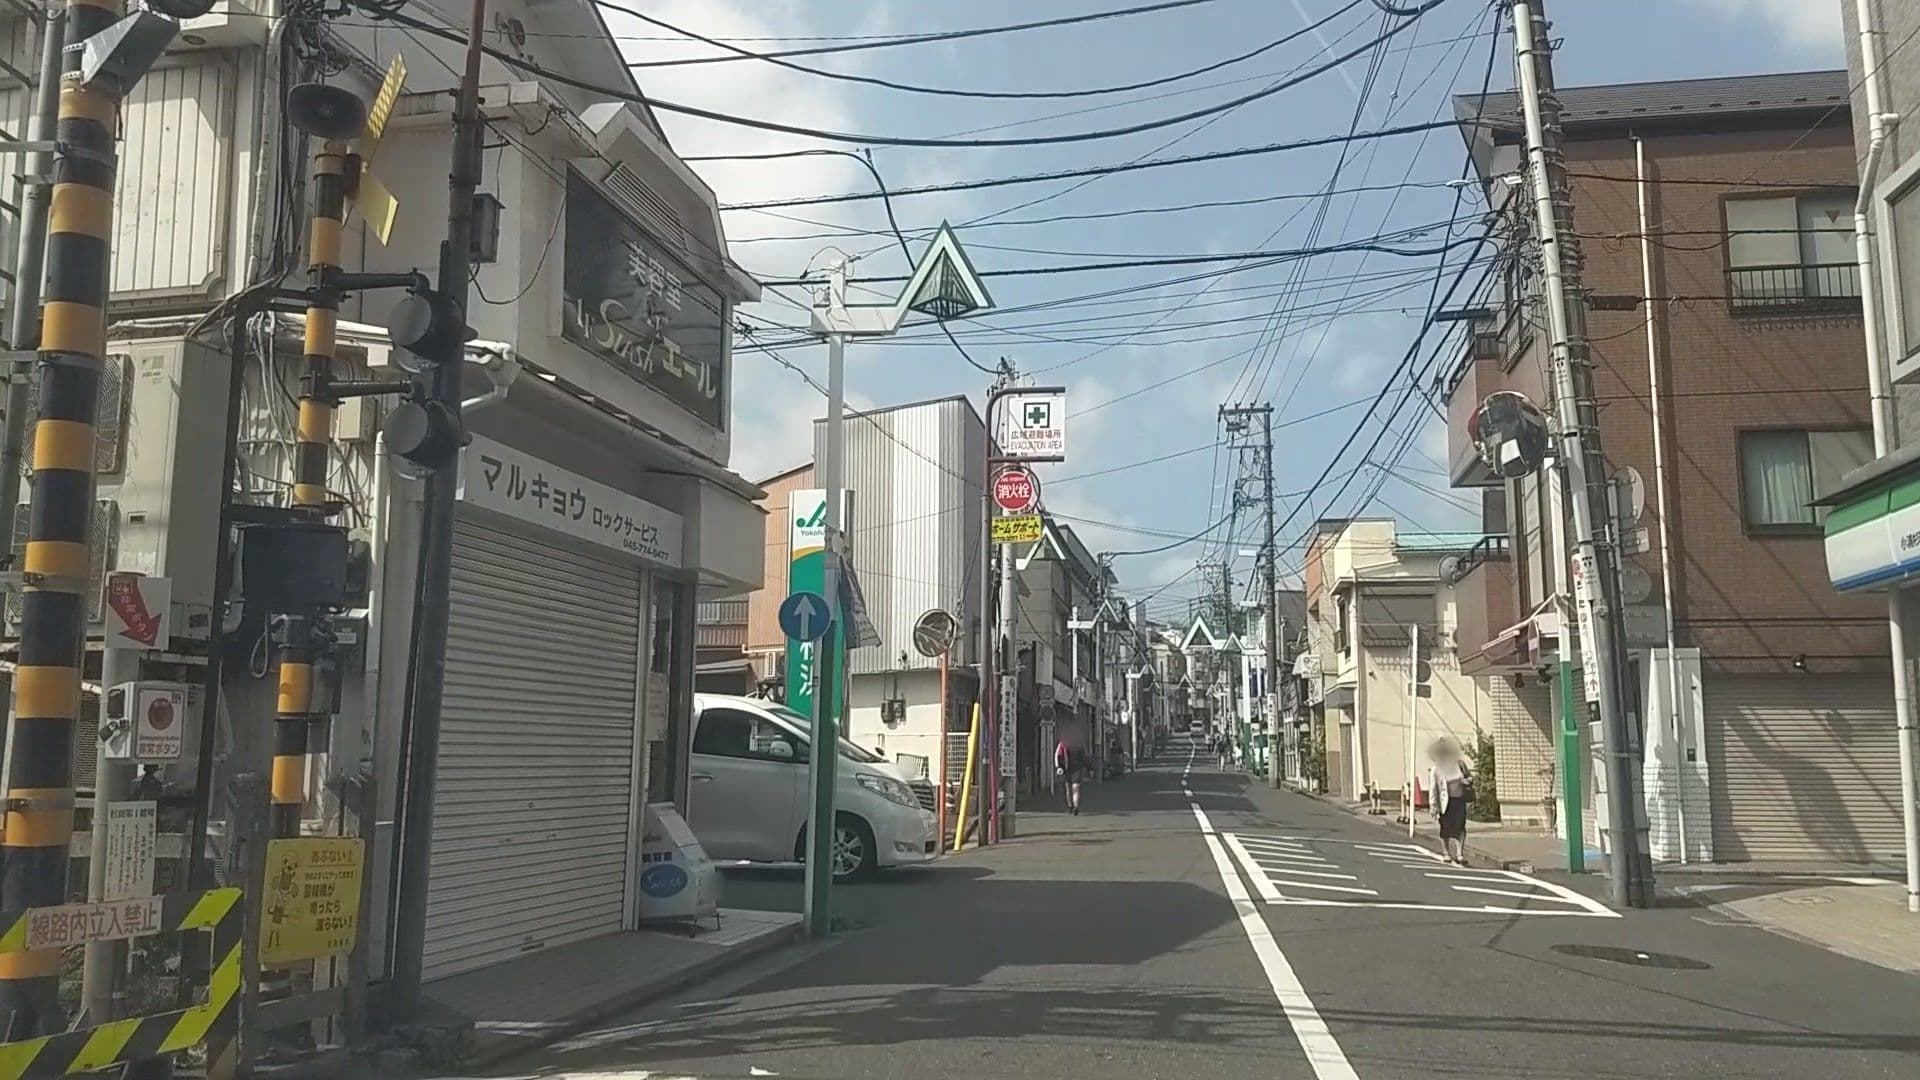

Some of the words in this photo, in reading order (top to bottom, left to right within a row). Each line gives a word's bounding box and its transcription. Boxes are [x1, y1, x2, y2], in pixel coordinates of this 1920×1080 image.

[662, 336, 717, 399] エール
[1011, 429, 1062, 440] 広域避難場所
[1010, 440, 1046, 450] EVACUATION
[1048, 440, 1063, 450] AREA
[998, 484, 1030, 499] 消火栓
[480, 454, 587, 521] マルキョウ
[593, 506, 659, 546] ロックサービス
[138, 743, 180, 756] 非常ボタン
[31, 901, 157, 944] 線路内立入禁止
